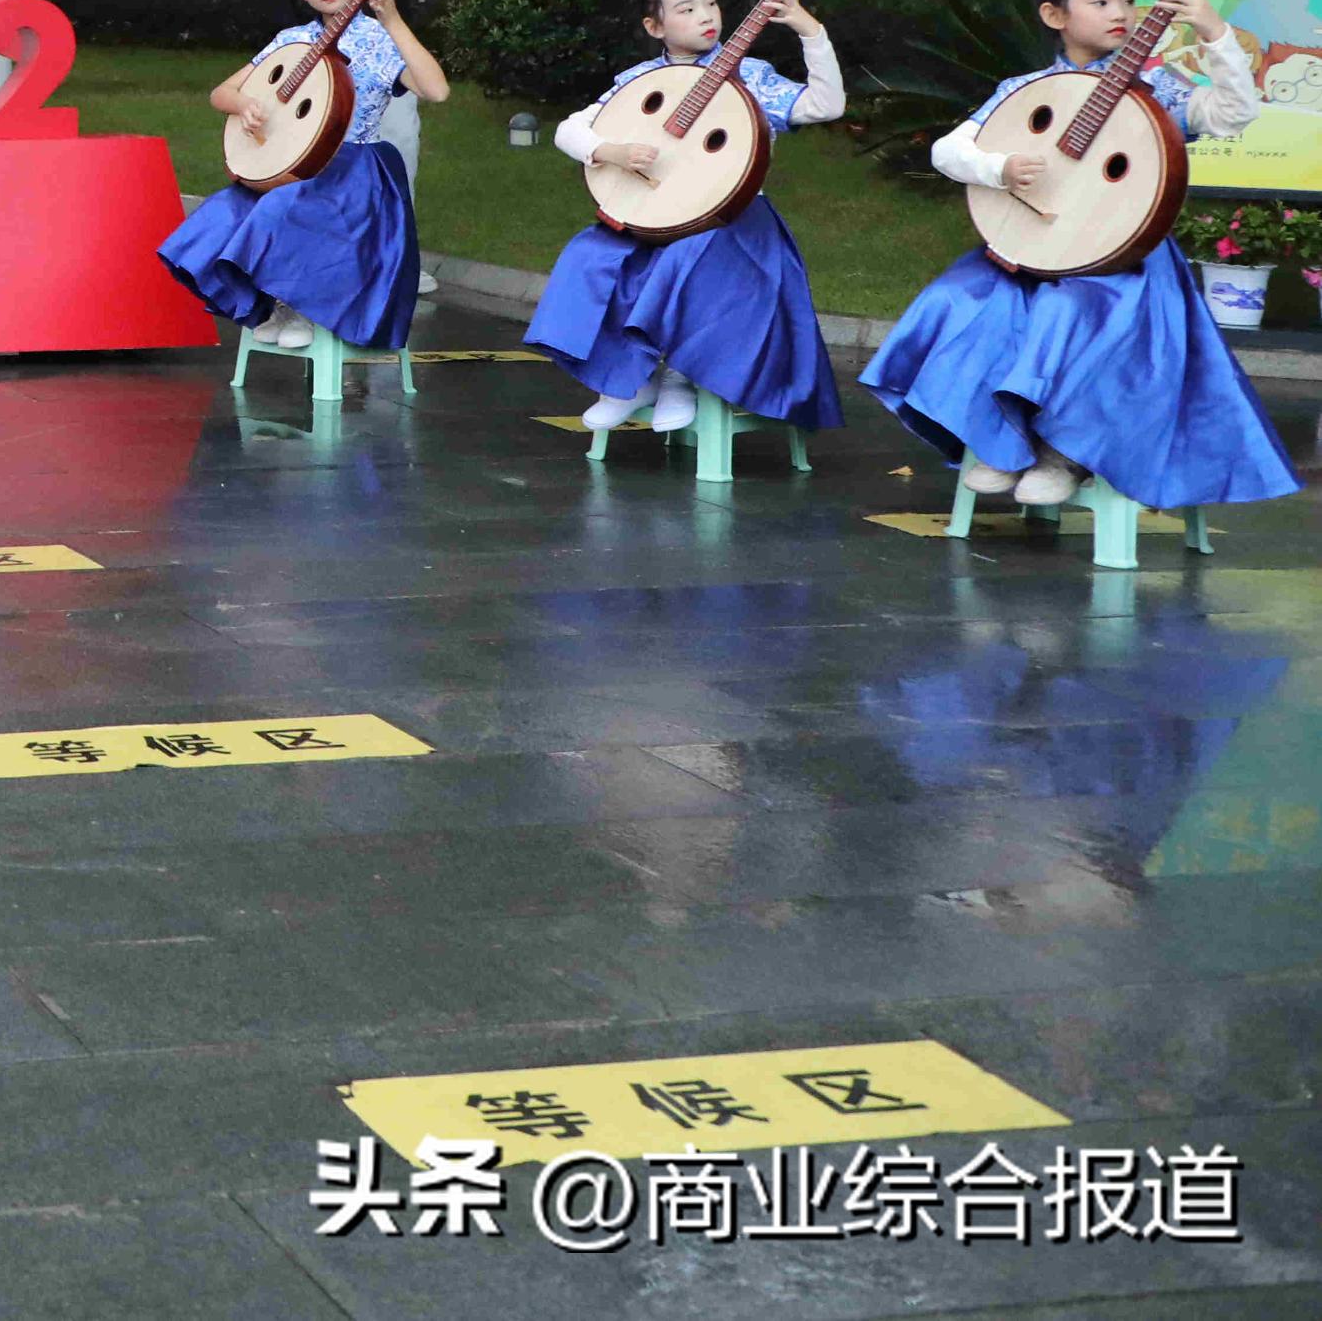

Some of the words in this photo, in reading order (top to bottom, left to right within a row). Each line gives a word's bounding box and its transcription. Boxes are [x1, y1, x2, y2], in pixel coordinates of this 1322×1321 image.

[23, 727, 347, 764] 等候区
[465, 1068, 929, 1139] 等候区
